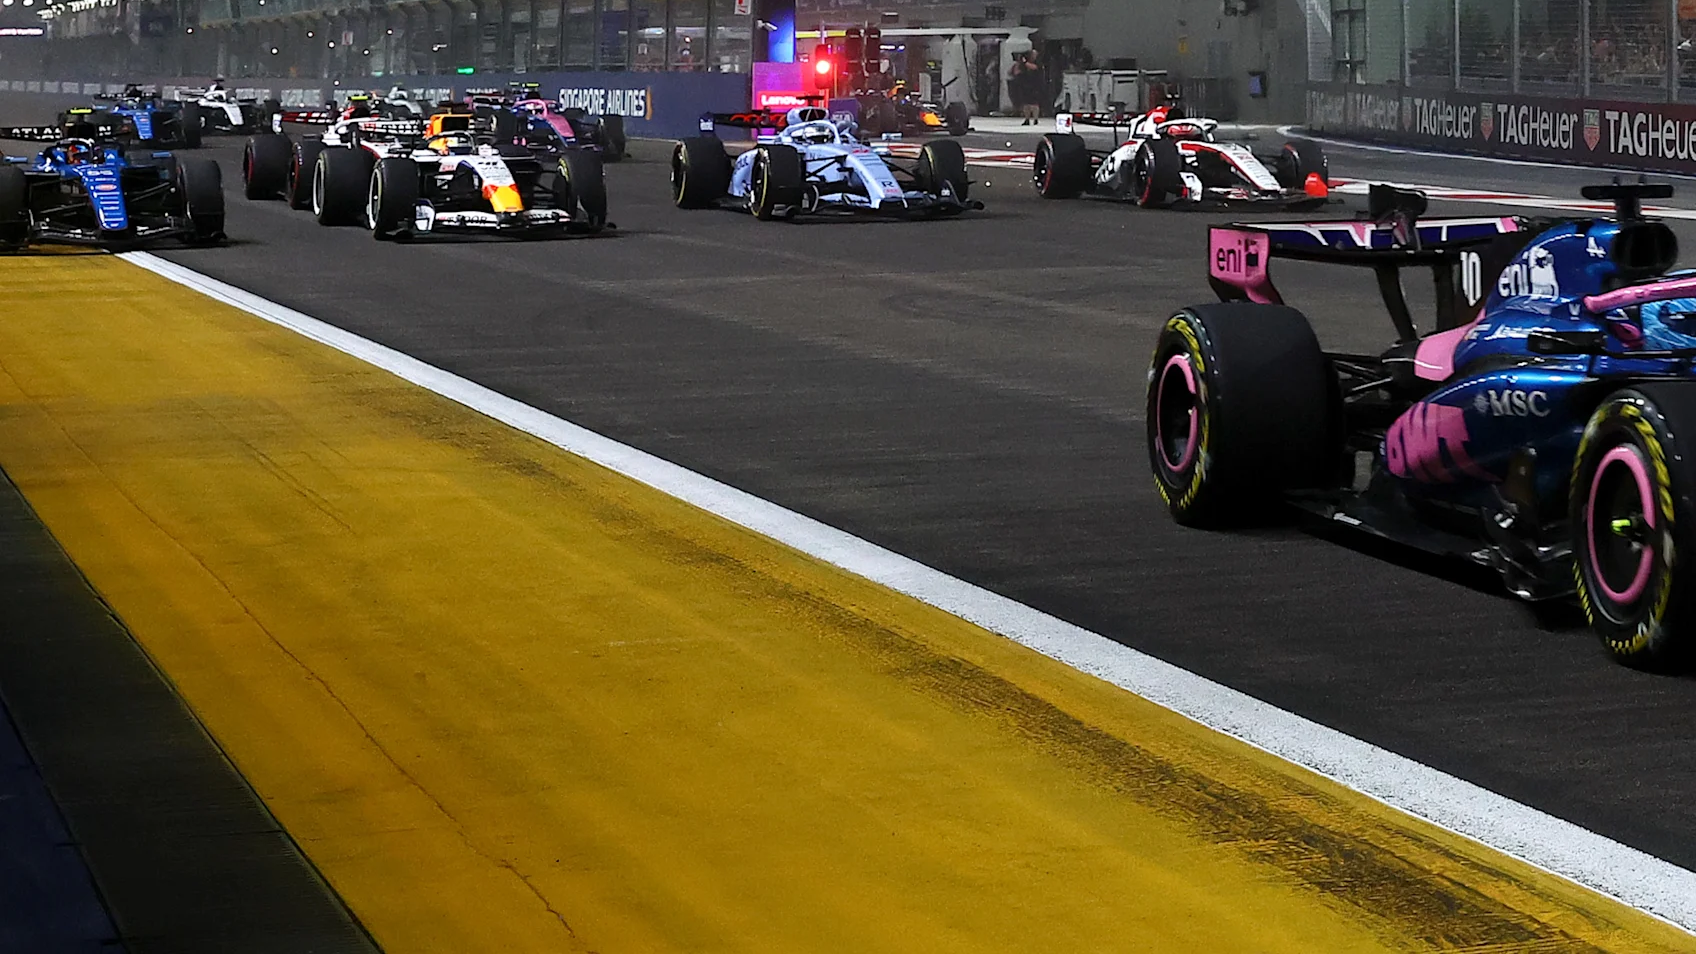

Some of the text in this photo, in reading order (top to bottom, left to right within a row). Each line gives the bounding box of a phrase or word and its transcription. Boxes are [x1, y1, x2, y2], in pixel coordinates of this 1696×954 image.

[559, 88, 646, 117] SINGAPORE AIRLINES
[1414, 98, 1477, 139] TAGHeuer
[12, 126, 111, 139] ATLAN
[1497, 104, 1579, 150] TAGHeuer
[1217, 240, 1242, 273] eni
[1499, 252, 1529, 297] eni
[1460, 251, 1482, 307] 10
[1487, 389, 1551, 417] MSC
[1386, 401, 1492, 483] BWT
